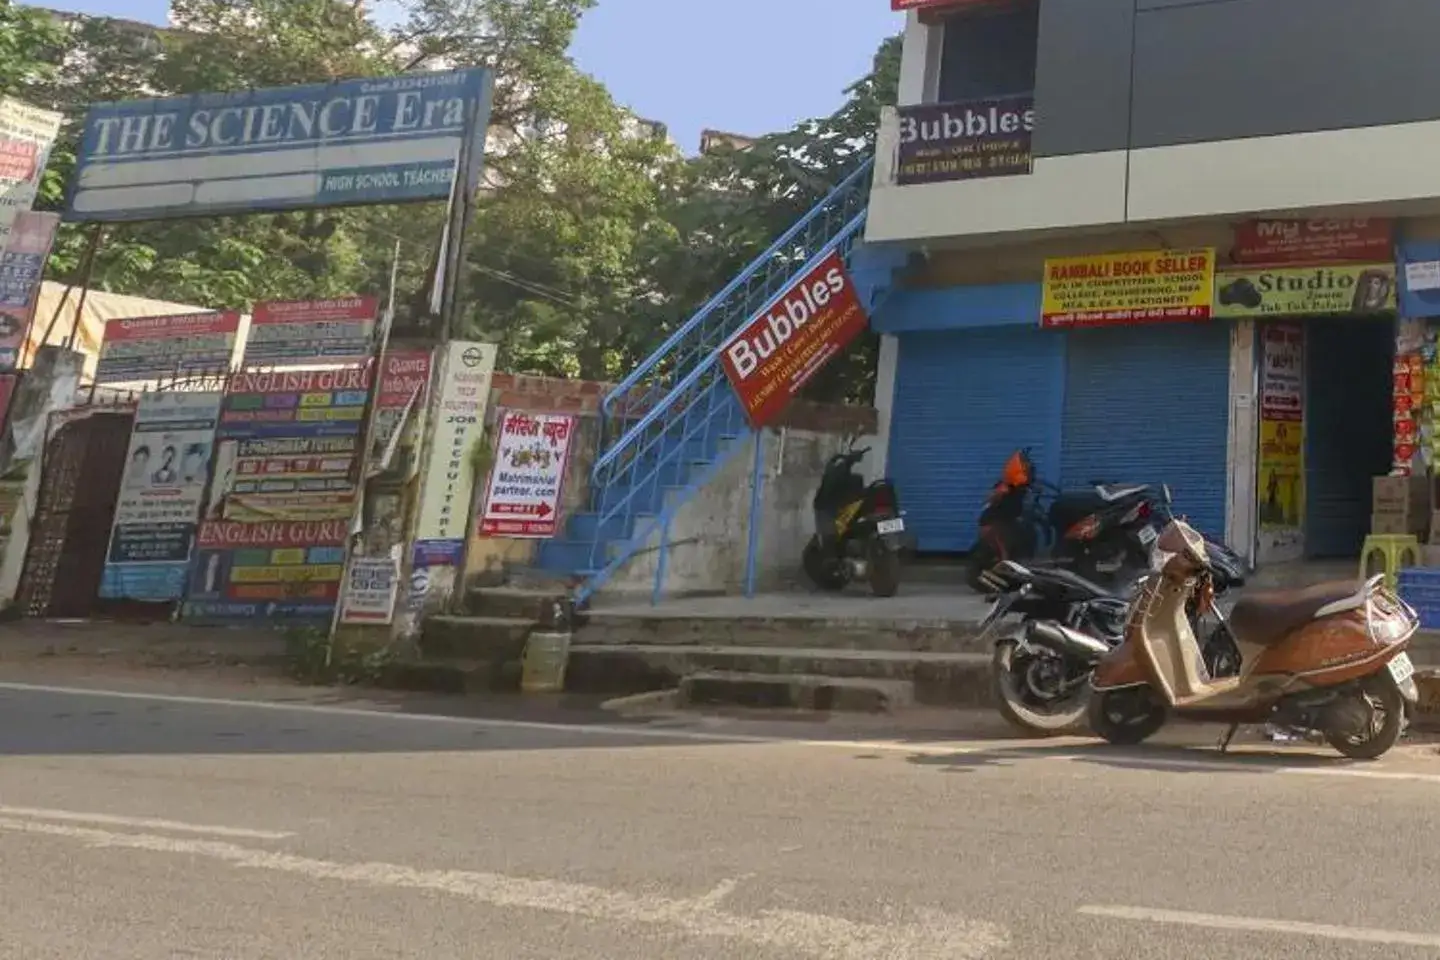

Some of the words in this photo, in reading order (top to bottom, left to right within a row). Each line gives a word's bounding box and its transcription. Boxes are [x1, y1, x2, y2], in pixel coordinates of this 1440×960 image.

[94, 113, 176, 155] THE
[185, 95, 379, 147] SCIENCE
[392, 91, 464, 131] Era
[900, 107, 1036, 143] Bubbles
[355, 171, 400, 190] SCHOOL
[1112, 259, 1152, 276] BOOK
[1155, 256, 1208, 274] SELLER
[1257, 269, 1355, 292] Studio
[728, 268, 844, 380] Bubbles
[229, 372, 313, 392] ENGLISH
[446, 415, 477, 424] JOB
[498, 472, 556, 486] Matrimonial
[535, 487, 556, 497] com
[199, 521, 284, 542] ENGLISH
